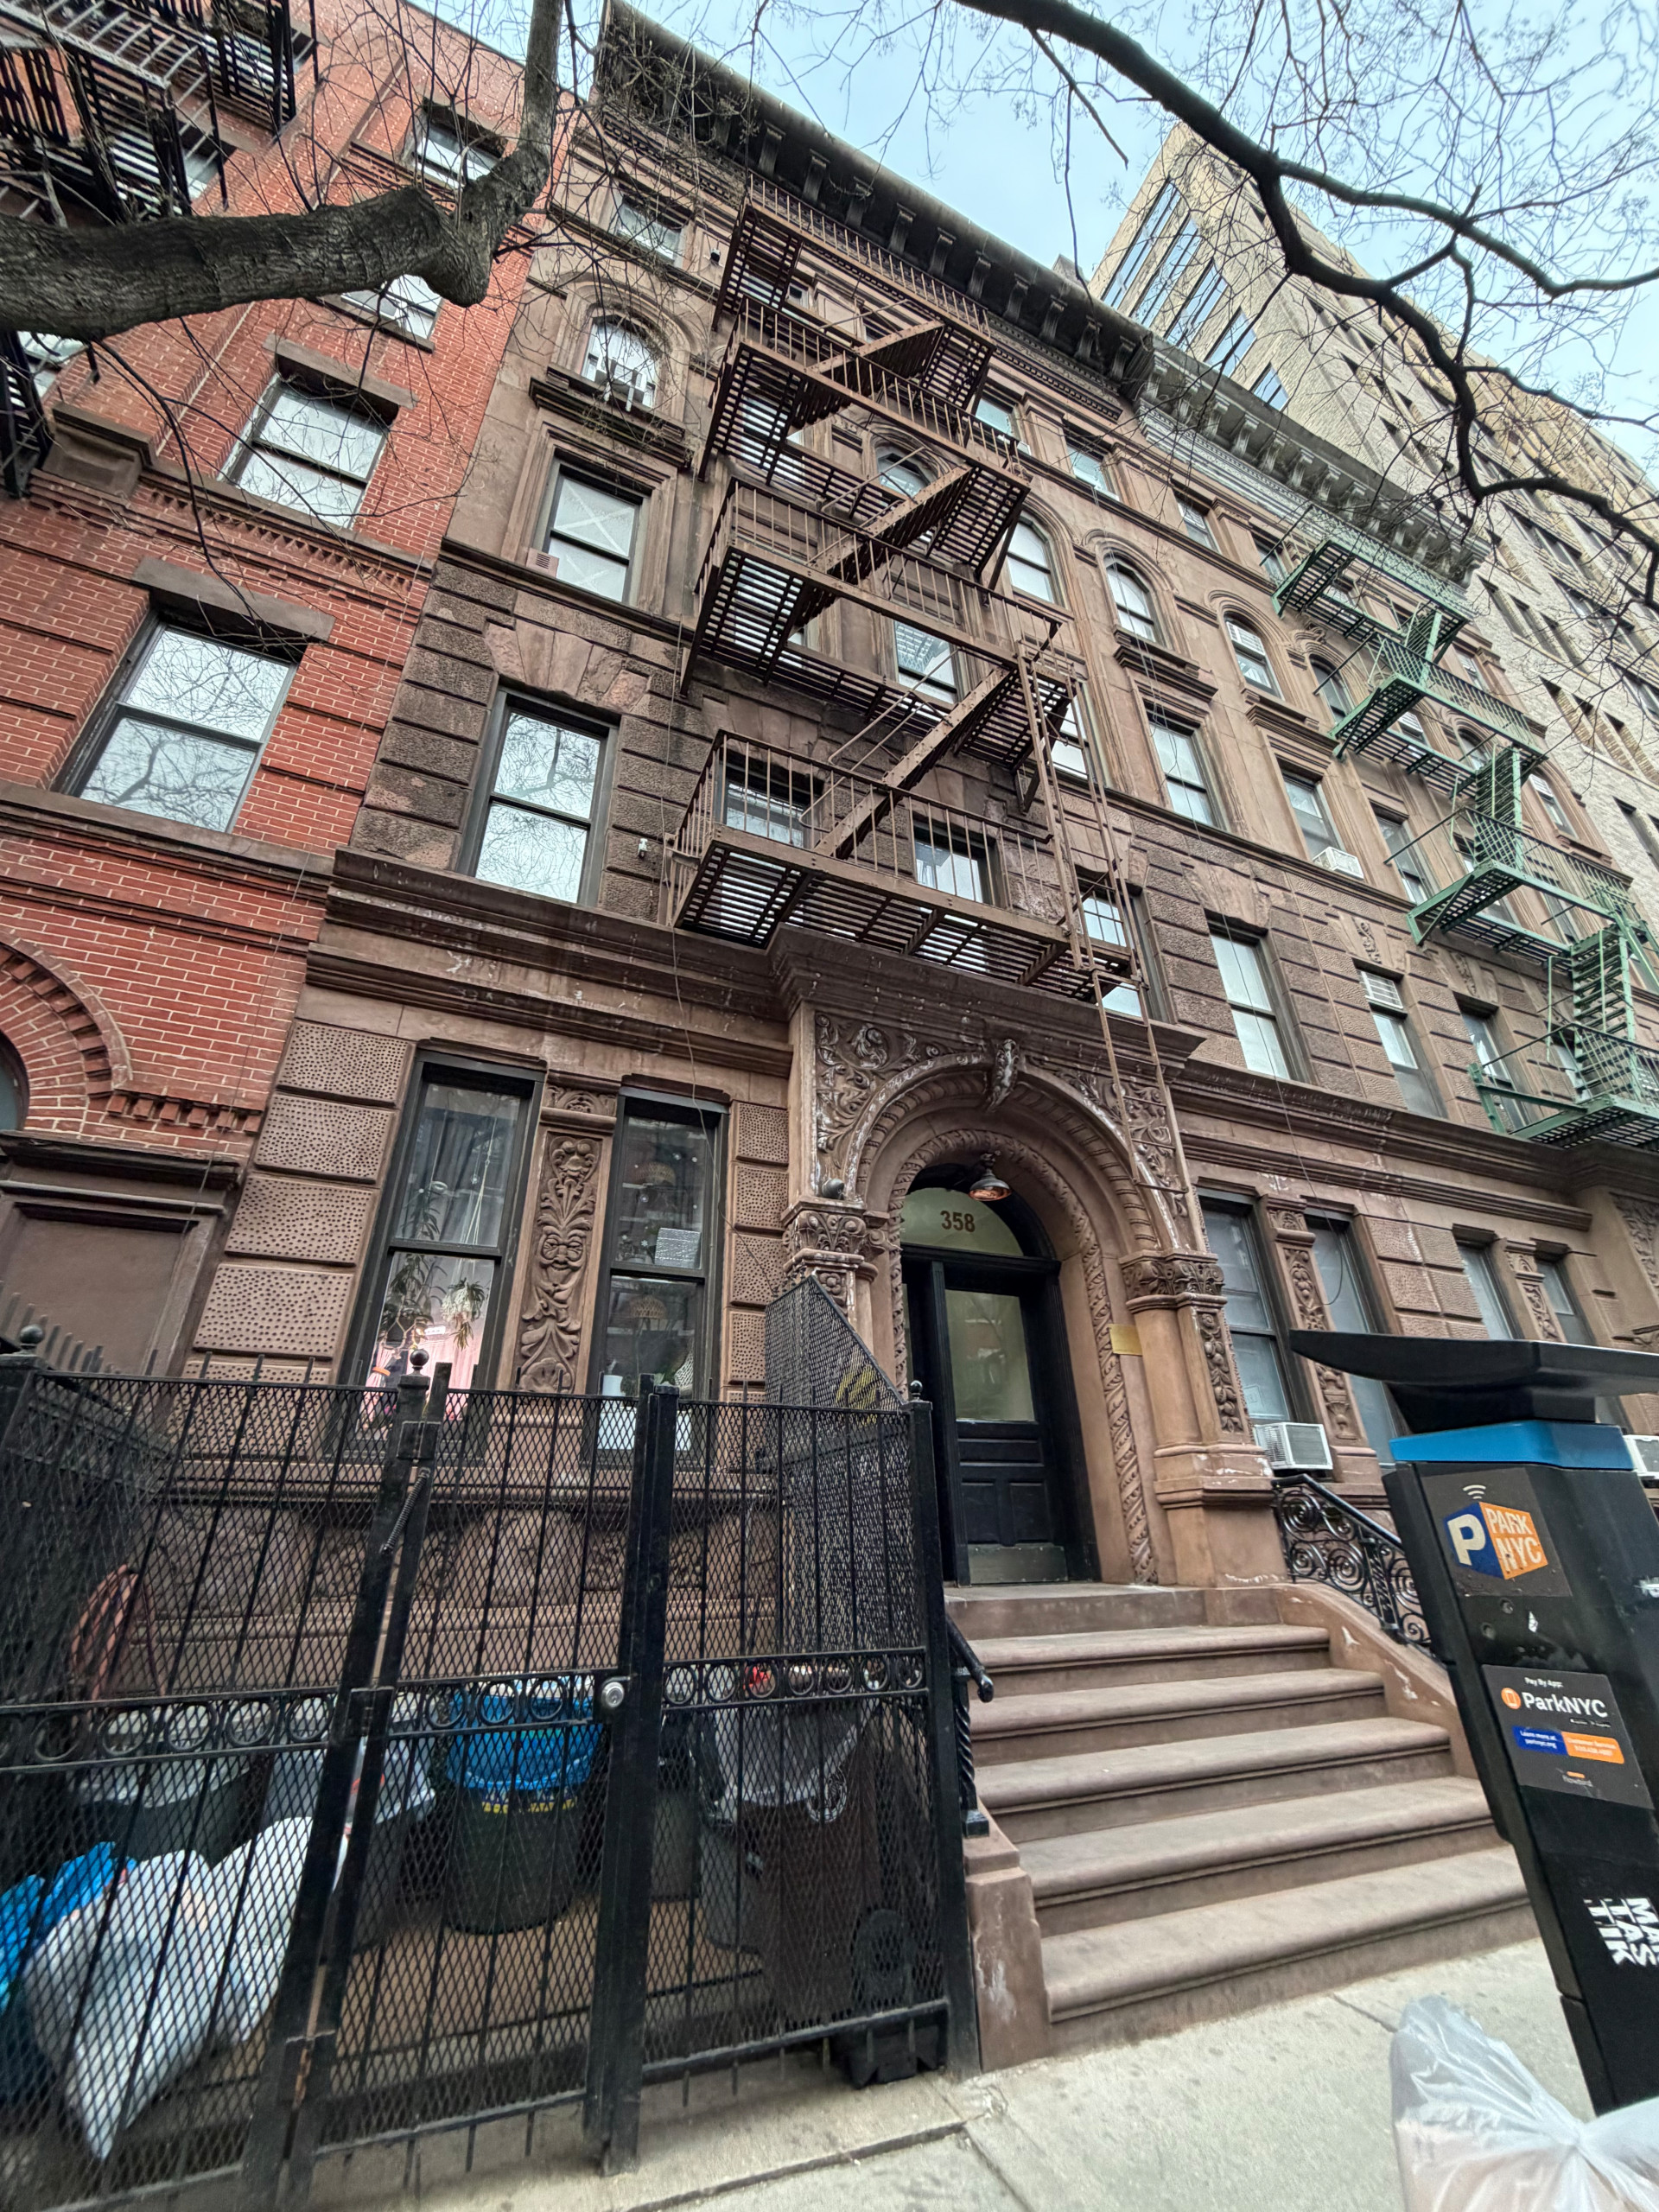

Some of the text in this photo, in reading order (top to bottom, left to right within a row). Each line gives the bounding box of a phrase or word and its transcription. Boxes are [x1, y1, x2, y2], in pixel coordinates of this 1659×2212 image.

[940, 1210, 976, 1233] 358
[1484, 1507, 1534, 1535] PARK
[1446, 1513, 1486, 1566] P
[1496, 1536, 1542, 1572] NYC
[1524, 1676, 1537, 1687] Pay
[1537, 1678, 1547, 1688] By
[1522, 1692, 1608, 1718] ParkNYC
[1586, 1898, 1637, 1965] TIK
[1605, 1897, 1657, 1967] TAS
